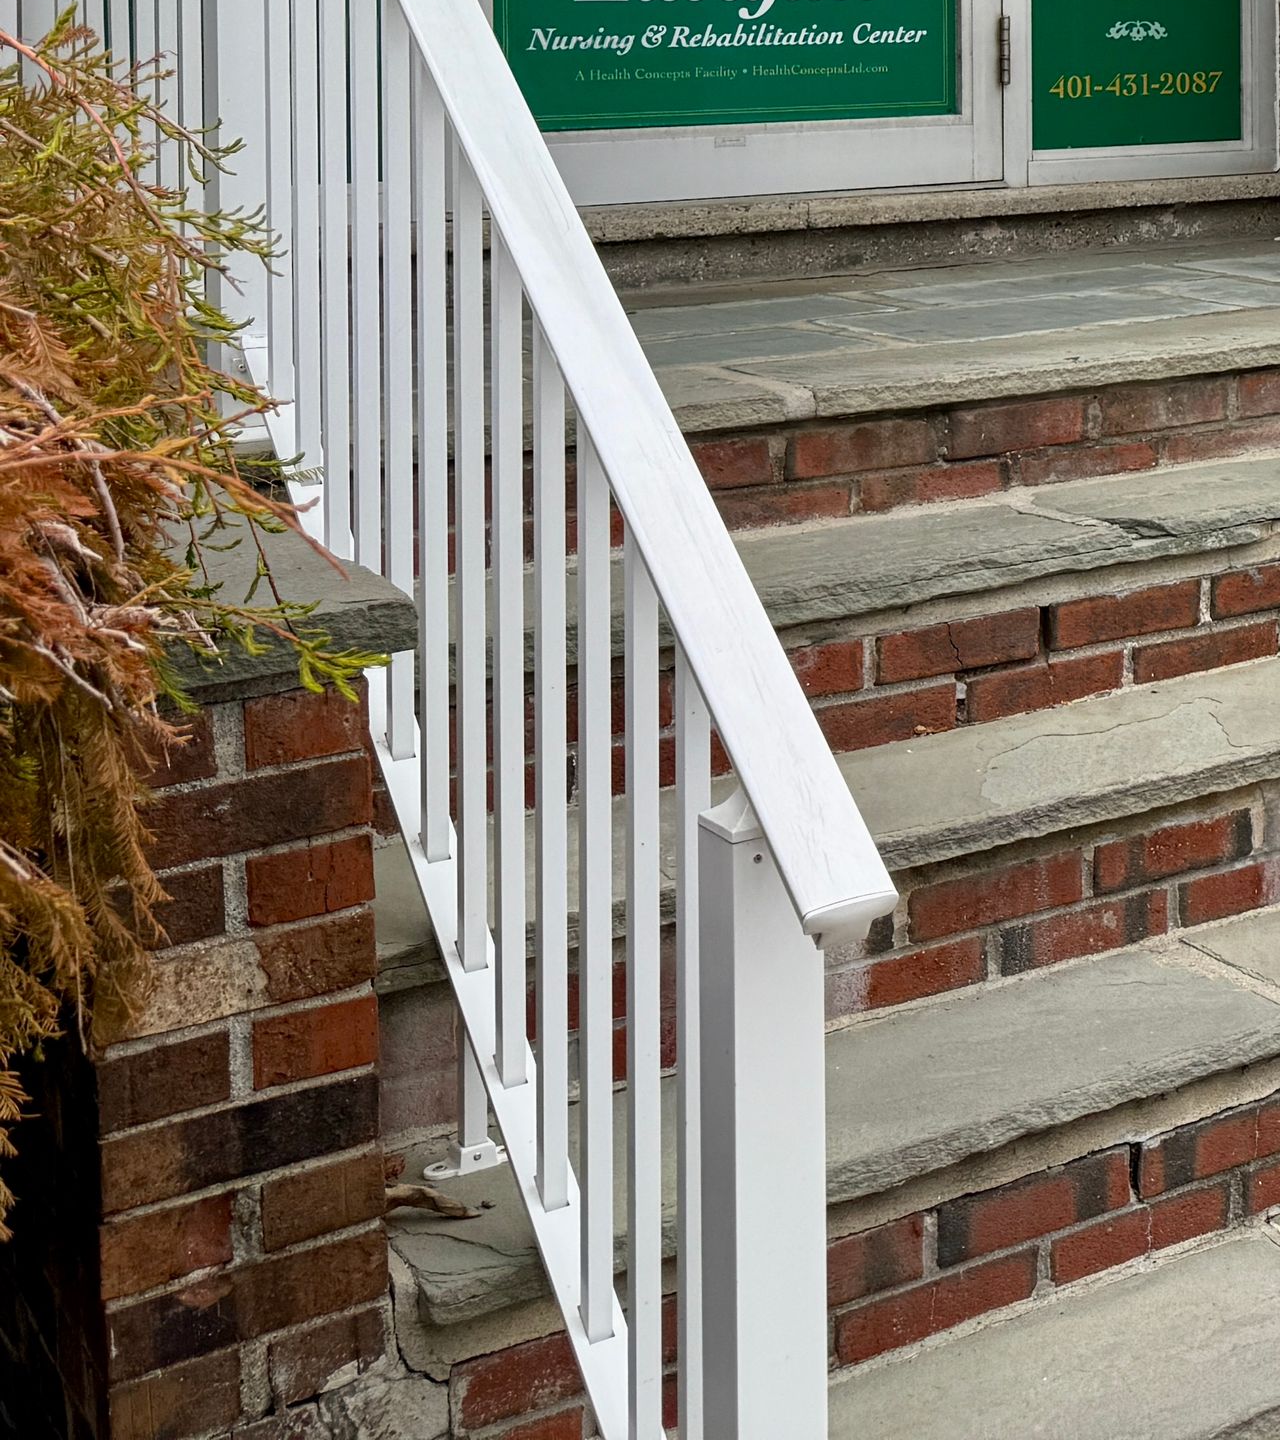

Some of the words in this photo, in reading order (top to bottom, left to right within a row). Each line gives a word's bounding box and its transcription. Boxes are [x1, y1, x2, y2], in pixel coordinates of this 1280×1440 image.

[526, 27, 635, 56] Nursing
[641, 24, 667, 49] &
[668, 23, 844, 49] Rehabilitation
[852, 22, 928, 46] Center
[575, 70, 585, 81] A
[590, 68, 631, 81] Health
[635, 68, 691, 82] Concepts
[695, 66, 738, 80] Facility
[1049, 70, 1224, 100] 401-431-2087
